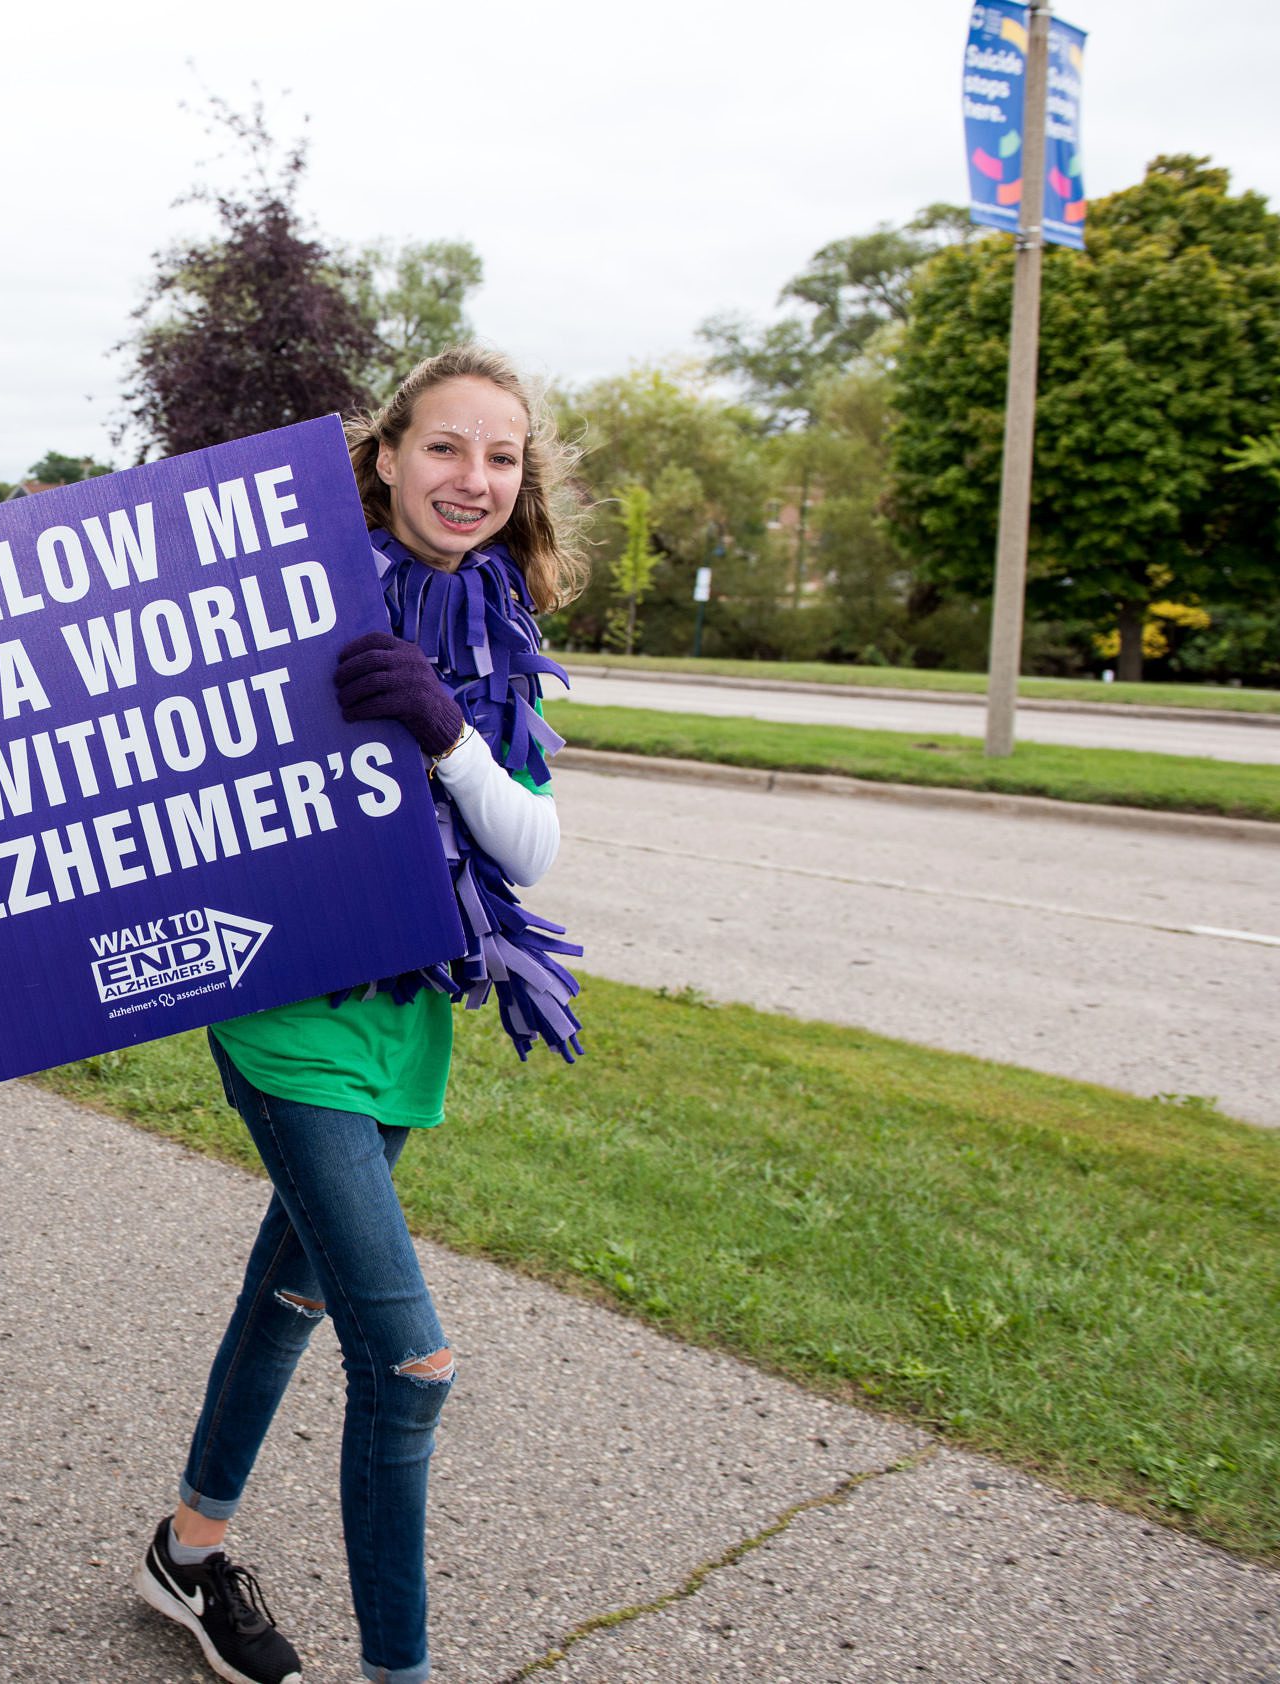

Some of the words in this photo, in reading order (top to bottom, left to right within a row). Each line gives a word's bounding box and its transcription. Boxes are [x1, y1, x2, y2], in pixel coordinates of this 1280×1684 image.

[183, 464, 308, 567] ME
[60, 560, 337, 697] WORLD
[89, 918, 168, 957] WALK
[168, 909, 204, 936] TO
[97, 937, 211, 987] END
[104, 960, 216, 999] ALZHEIMER'S
[108, 999, 158, 1019] alzheimer's
[176, 981, 226, 1001] association
